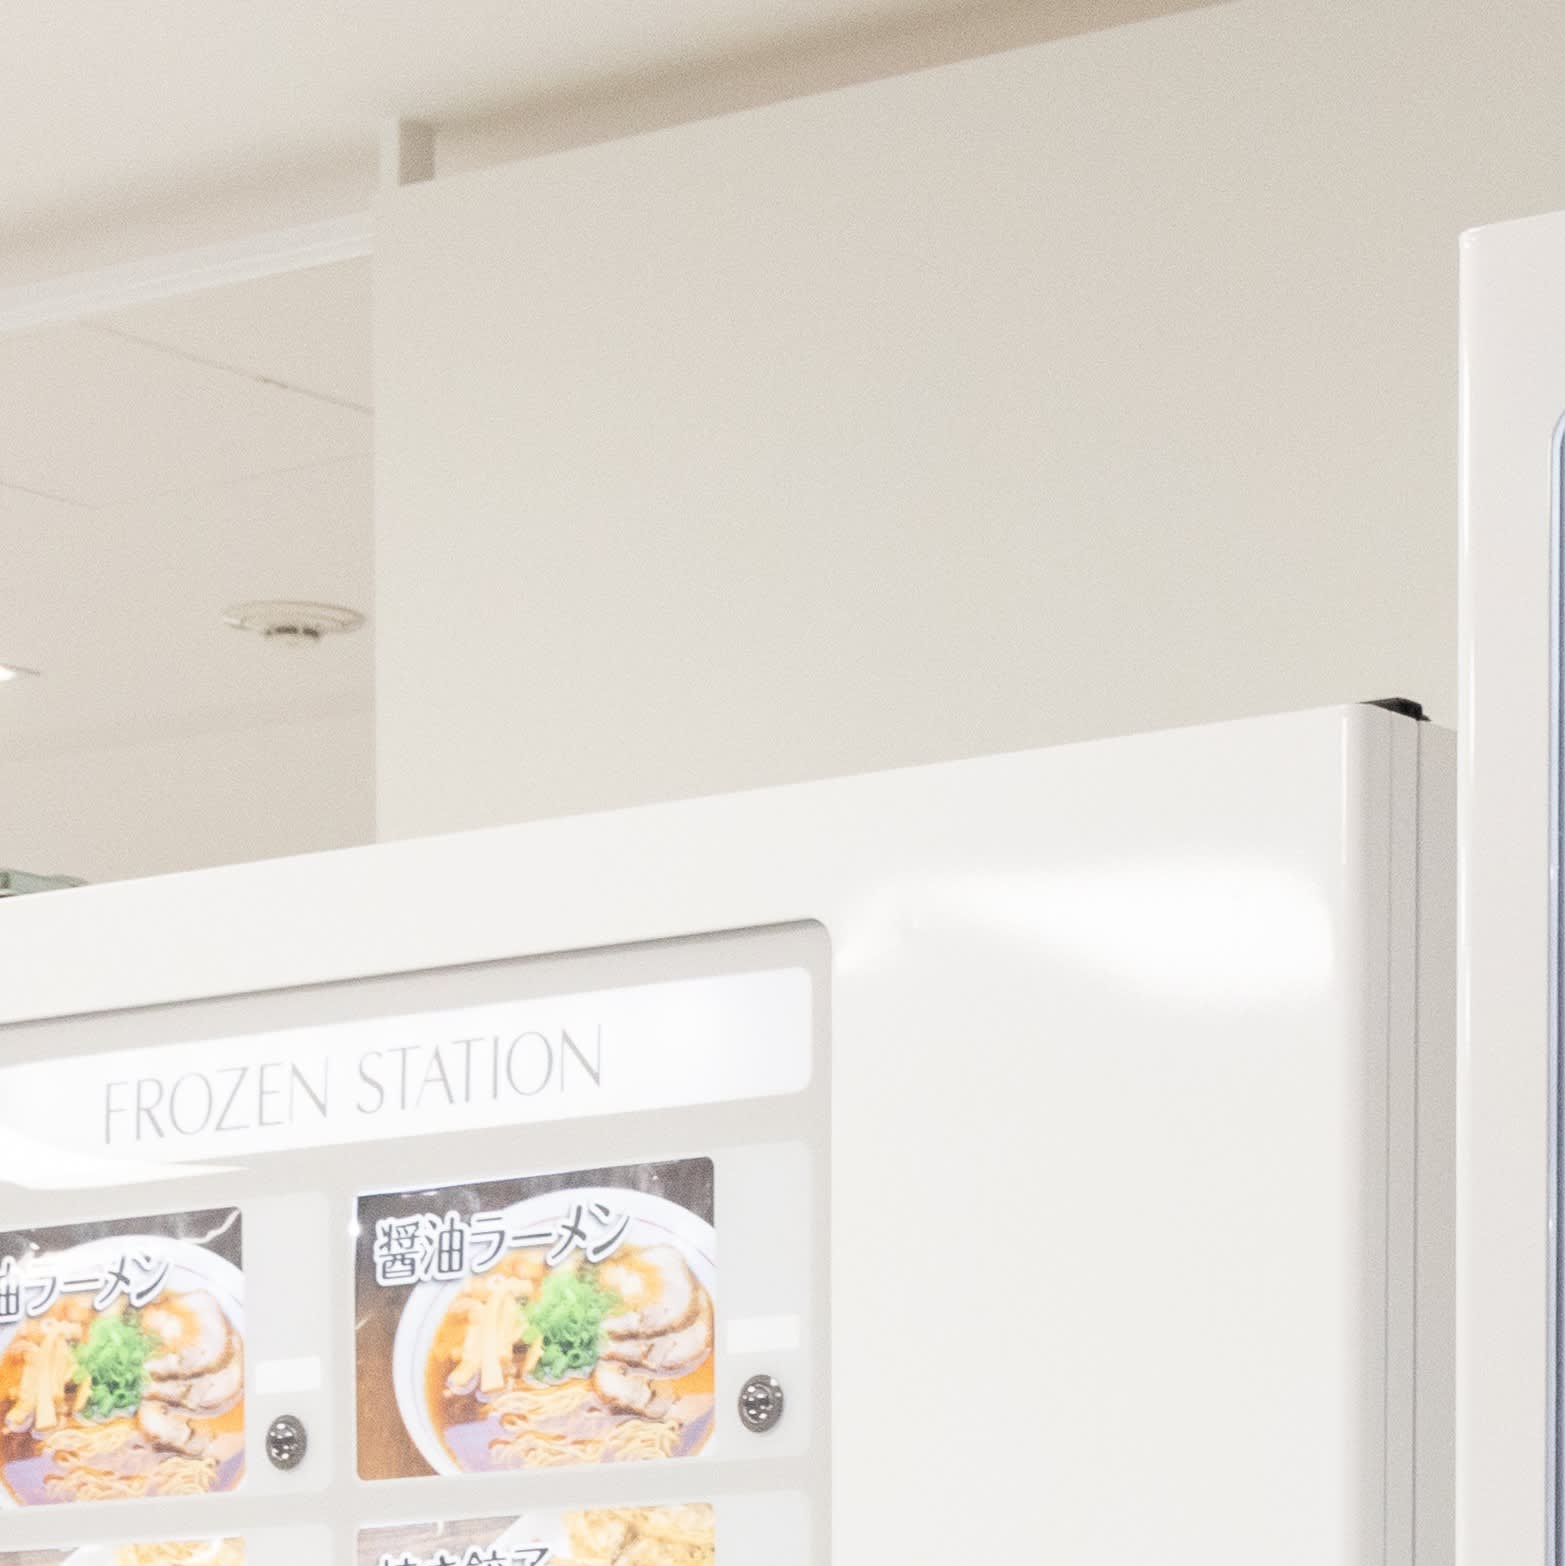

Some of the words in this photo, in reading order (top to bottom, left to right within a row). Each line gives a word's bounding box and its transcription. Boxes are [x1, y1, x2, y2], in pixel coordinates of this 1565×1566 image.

[104, 1056, 330, 1146] FROZEN
[356, 1023, 605, 1116] STATION
[375, 1200, 631, 1285] 醤油ラーメン
